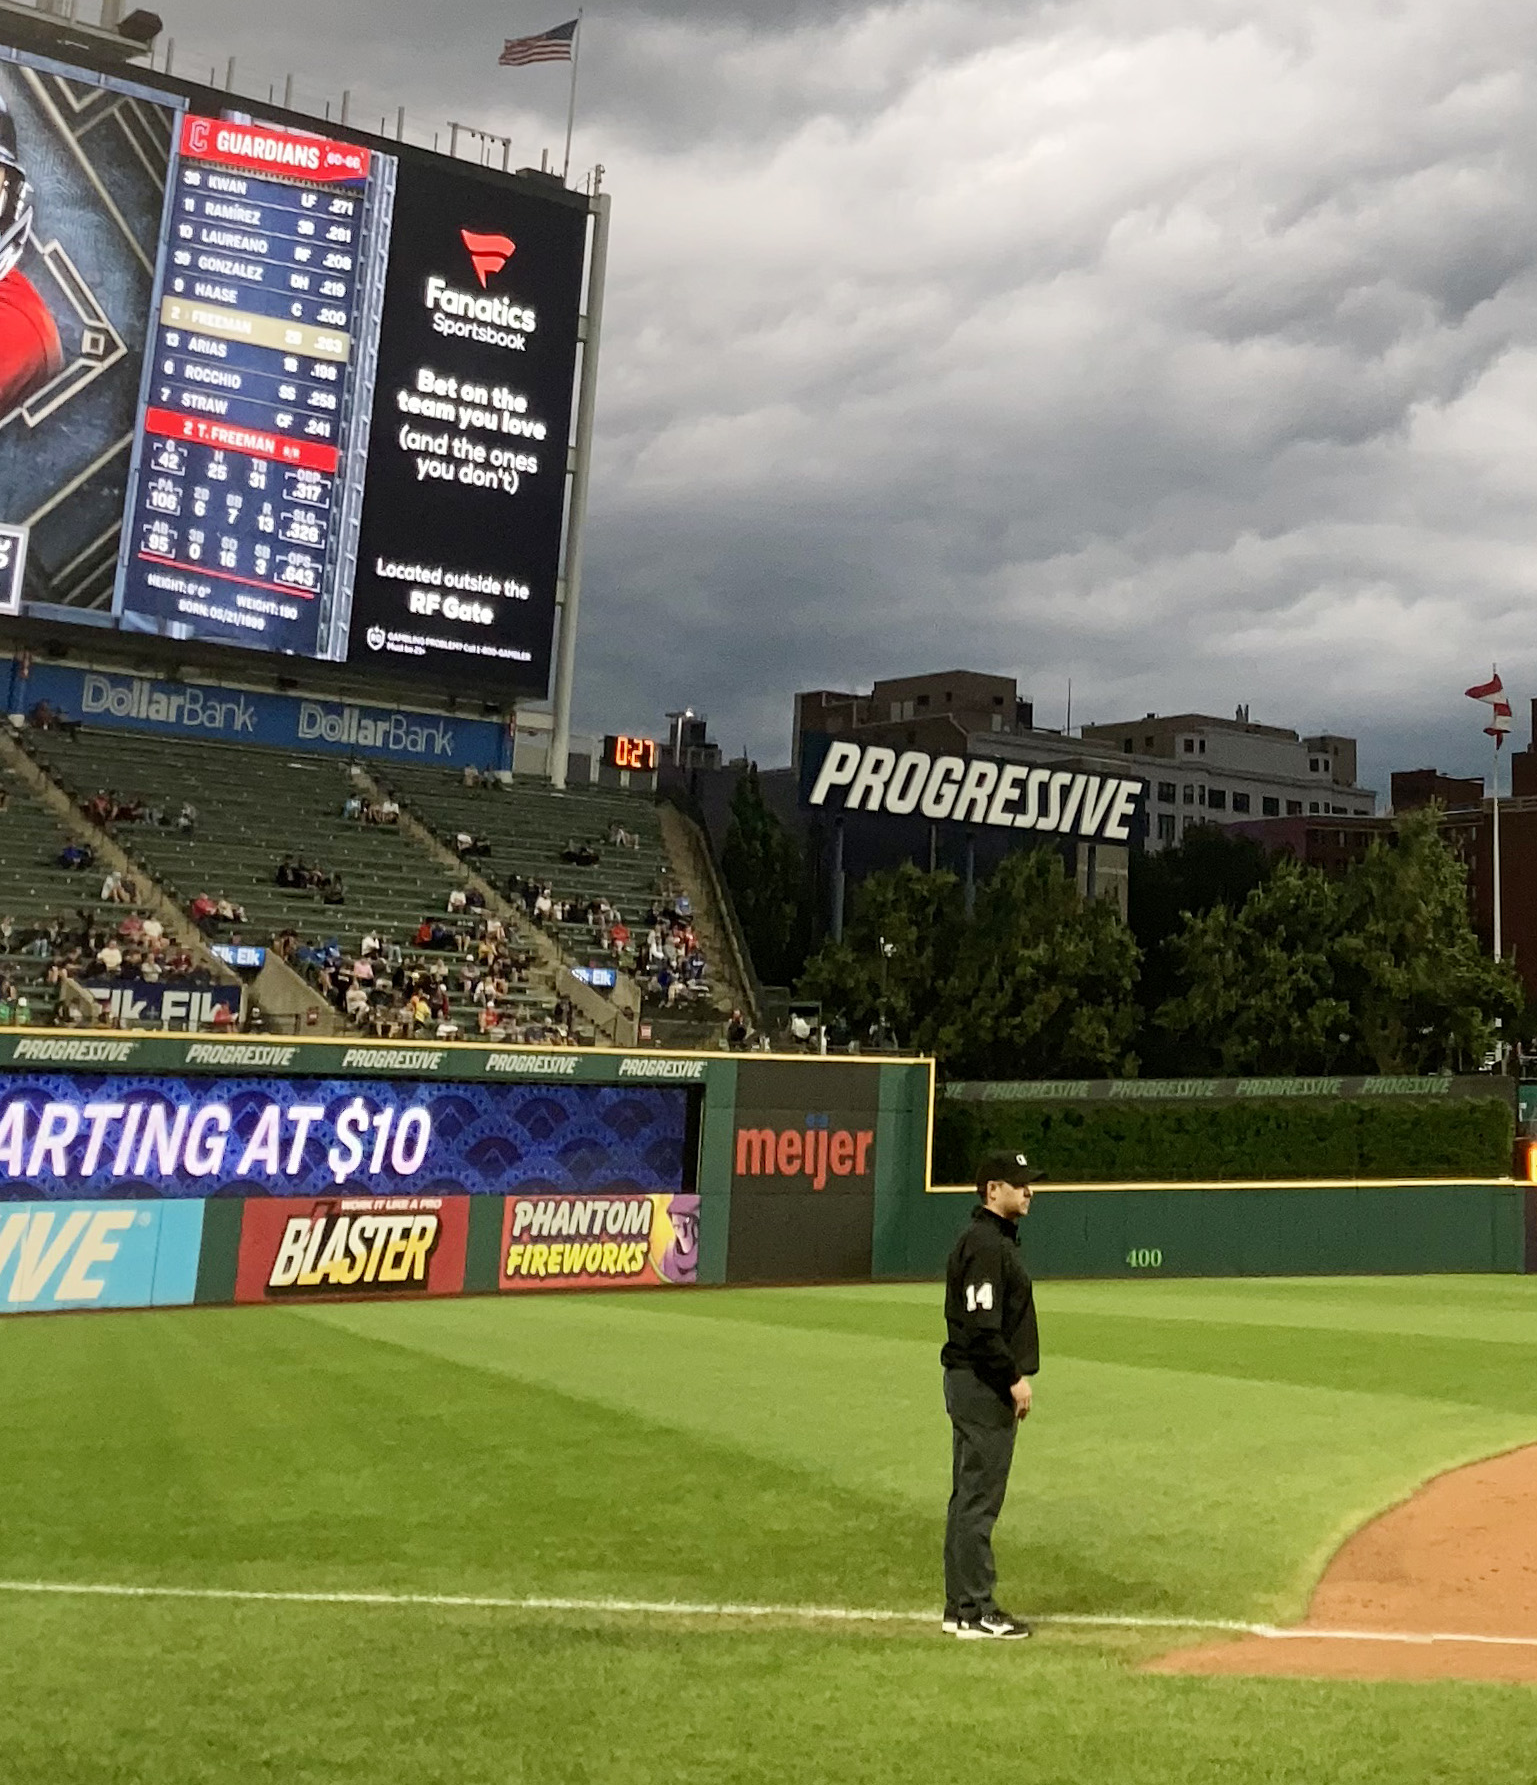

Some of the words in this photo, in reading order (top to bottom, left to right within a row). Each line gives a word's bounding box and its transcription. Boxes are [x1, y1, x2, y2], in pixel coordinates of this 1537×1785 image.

[217, 131, 320, 169] GUARDIANS
[208, 175, 248, 195] KWAN
[205, 202, 261, 226] RAMÍREZ
[202, 229, 269, 254] LAUREANO
[198, 255, 264, 282] GONZALEZ
[195, 282, 238, 304] HAASE
[425, 276, 537, 333] Fanatics
[191, 310, 252, 335] FREEMAN
[432, 313, 527, 352] Sportsbook
[188, 336, 228, 358] ARIAS
[184, 364, 242, 390] ROCCHIO
[417, 368, 458, 398] Bet
[460, 383, 489, 405] on
[491, 388, 528, 414] the
[181, 392, 228, 415] STRAW
[304, 420, 331, 437] .241
[397, 390, 456, 422] team
[458, 406, 499, 430] you
[501, 410, 547, 440] love
[211, 426, 276, 454] FREEMAN
[399, 423, 449, 456] (and
[452, 436, 488, 463] the
[489, 448, 538, 474] ones
[158, 451, 180, 470] 42
[249, 471, 266, 490] 31
[292, 483, 322, 502] .317
[416, 457, 455, 481] you
[458, 462, 520, 495] don't)
[257, 514, 275, 533] 13
[220, 550, 237, 568] 16
[376, 557, 443, 586] Located
[443, 571, 502, 596] outside
[503, 578, 530, 601] the
[409, 589, 442, 616] RF
[442, 595, 495, 625] Gate
[81, 673, 255, 732] DollarBank
[297, 701, 452, 756] DollarBank
[614, 735, 655, 768] 0:27
[808, 740, 1144, 841] PROGRESSIVE
[13, 1038, 134, 1064] PROGRESSIVE
[185, 1043, 296, 1067] PROGRESSIVE
[342, 1048, 443, 1071] PROGRESSIVE
[484, 1052, 579, 1075] PROGRESSIVE
[618, 1056, 704, 1078] PROGRESSIVE
[982, 1079, 1090, 1100] PROGRESSIVE
[1108, 1079, 1217, 1099] PROGRESSIVE
[1235, 1078, 1344, 1096] PROGRESSIVE
[1360, 1076, 1454, 1094] PROGRESSIVE
[0, 1103, 232, 1177] ARTING
[240, 1104, 327, 1177] AT
[328, 1097, 433, 1185] $10
[735, 1113, 874, 1191] meijer
[512, 1200, 654, 1238] PHANTOM
[268, 1215, 439, 1289] BLASTER
[505, 1242, 646, 1277] FIREWORKS
[1125, 1248, 1163, 1268] 400
[965, 1281, 993, 1312] 14
